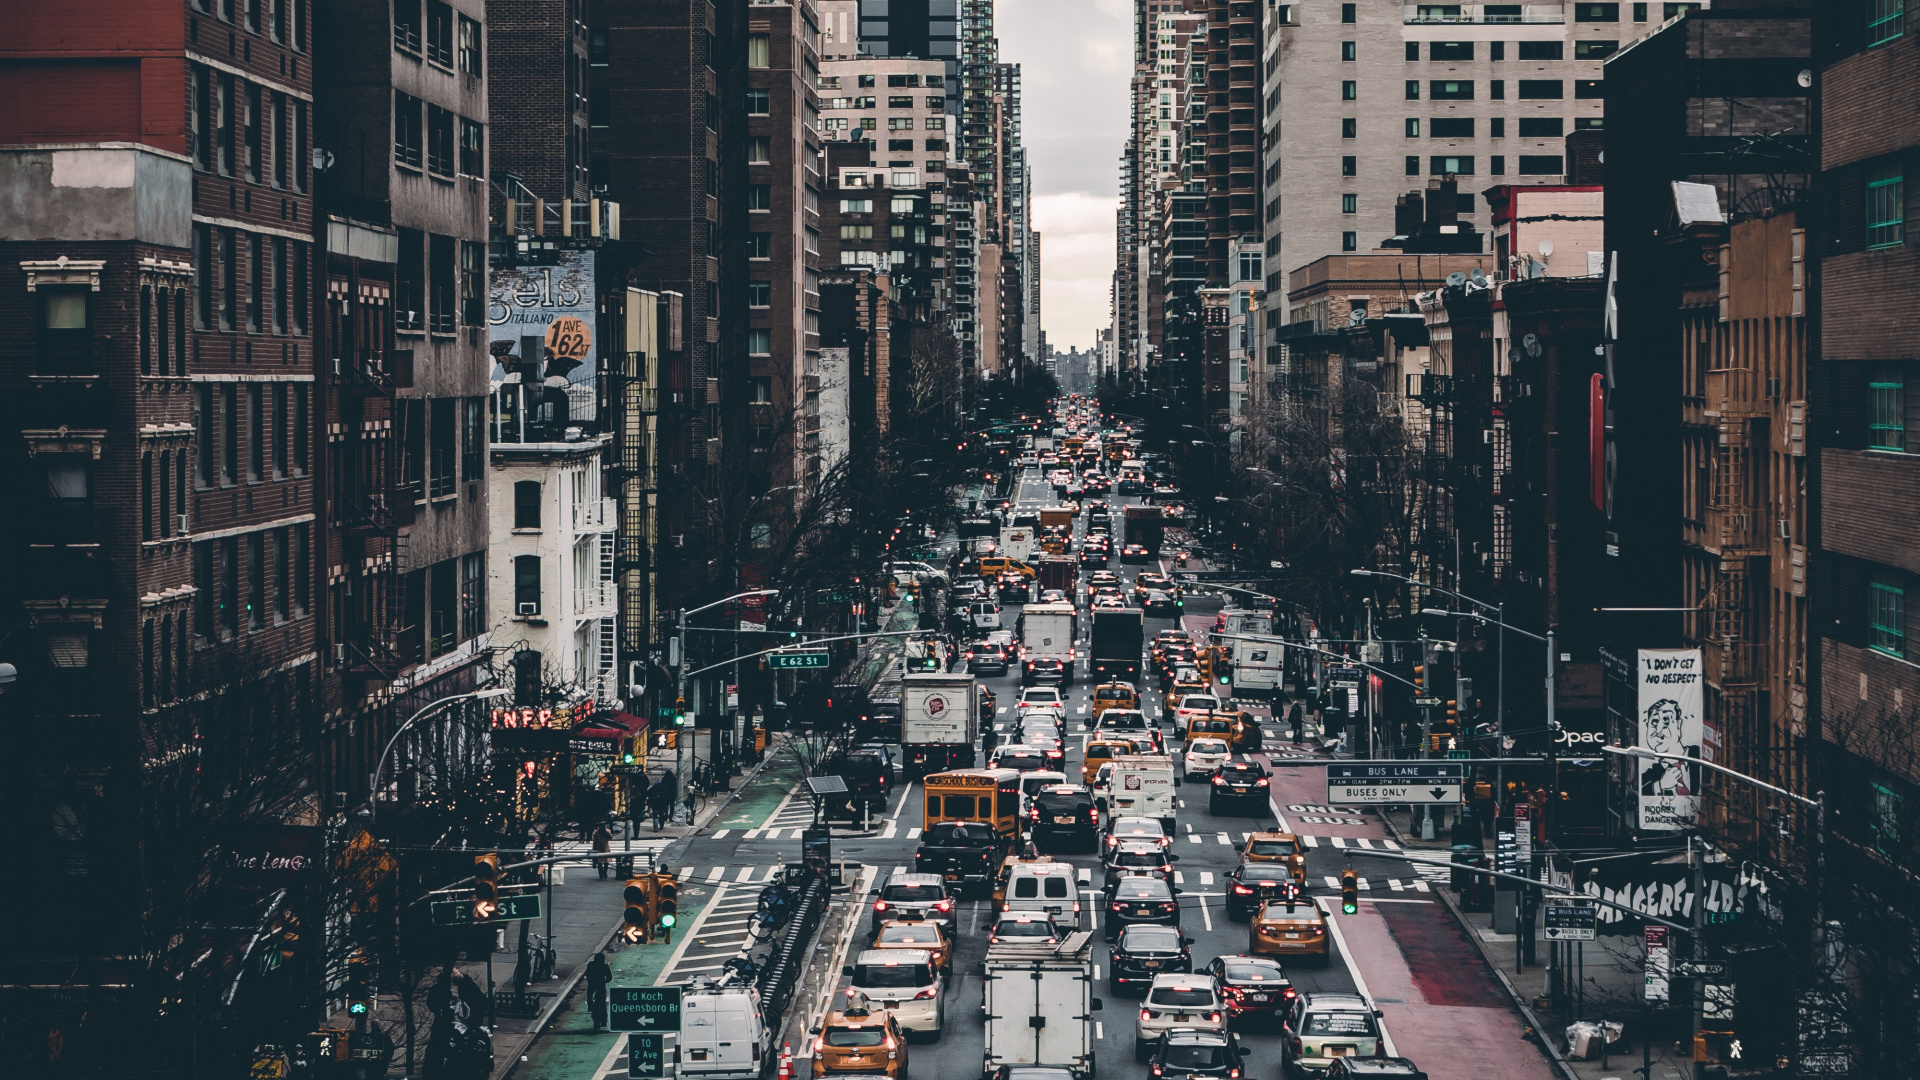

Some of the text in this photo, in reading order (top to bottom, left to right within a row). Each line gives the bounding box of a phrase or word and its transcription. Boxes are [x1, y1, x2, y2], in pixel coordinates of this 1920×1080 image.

[510, 313, 554, 325] ITALIANO
[551, 320, 582, 347] 1 AVE
[558, 333, 591, 356] 62 ST
[780, 655, 818, 666] E 62 St
[1654, 656, 1679, 670] DON'T
[1680, 658, 1695, 669] GET
[1645, 673, 1660, 684] NO
[1368, 767, 1419, 776] BUS LANE
[943, 777, 977, 786] SCHOOL BUS
[1346, 788, 1407, 797] BUSES ONLY
[1288, 804, 1363, 815] ONLY
[1644, 805, 1676, 814] RODNEY
[1301, 816, 1365, 825] BUS
[497, 902, 517, 916] St
[1711, 913, 1716, 924] E
[1682, 965, 1696, 974] ONE
[626, 992, 663, 1001] Ed Koch
[611, 1003, 679, 1014] Queensboro Br
[640, 1038, 651, 1048] TO
[634, 1050, 658, 1059] 2 Ave
